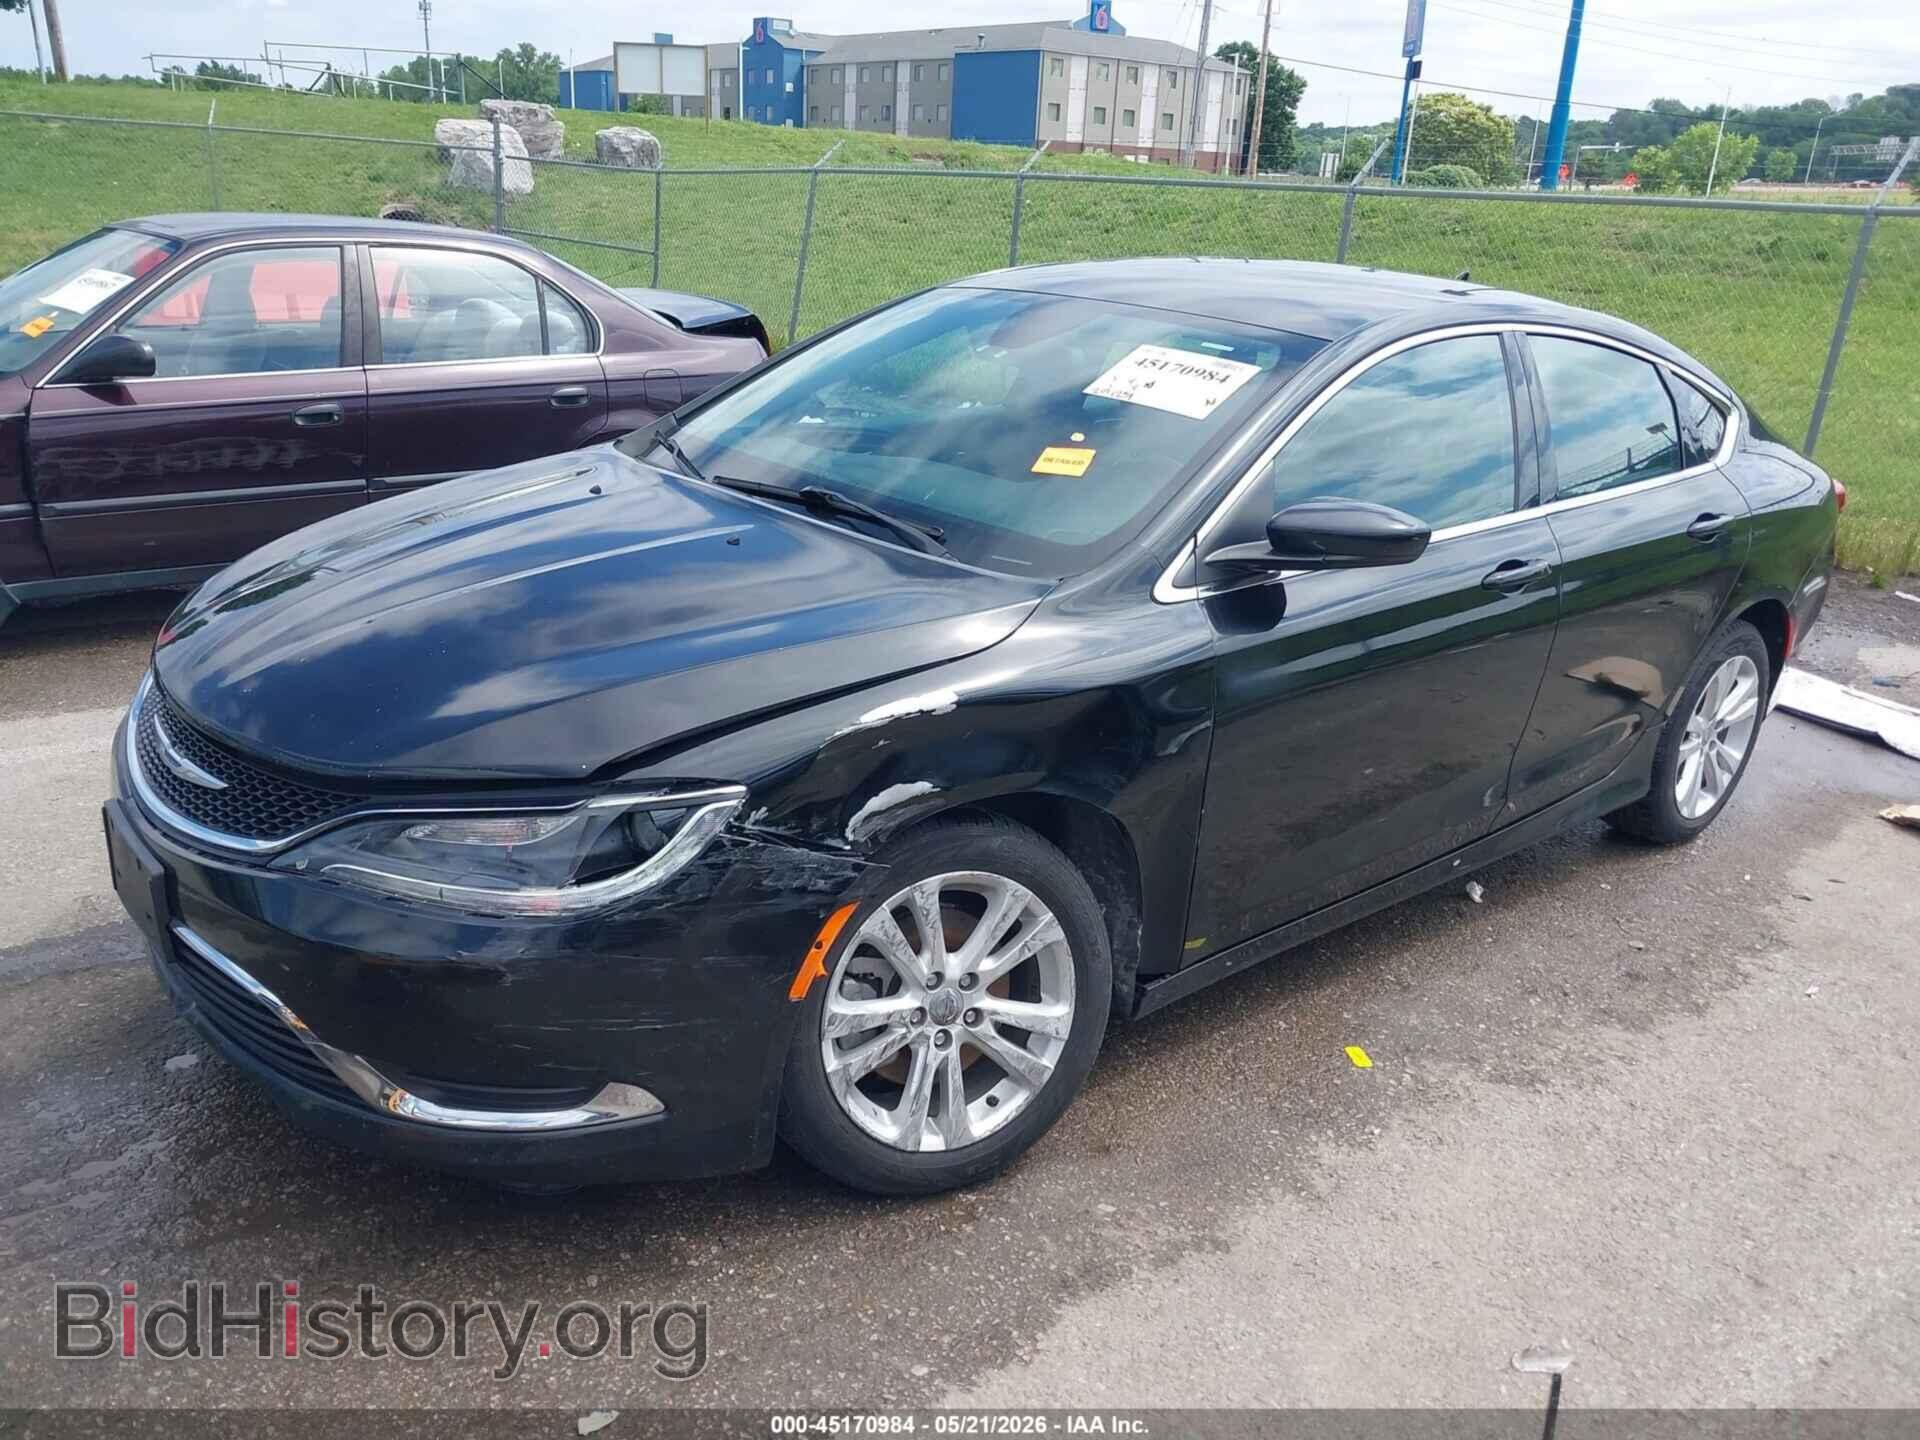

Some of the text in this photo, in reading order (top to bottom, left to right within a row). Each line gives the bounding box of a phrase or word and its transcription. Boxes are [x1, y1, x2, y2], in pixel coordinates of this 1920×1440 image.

[1096, 5, 1108, 30] 6
[755, 21, 764, 43] 6
[1135, 357, 1232, 384] 45170984
